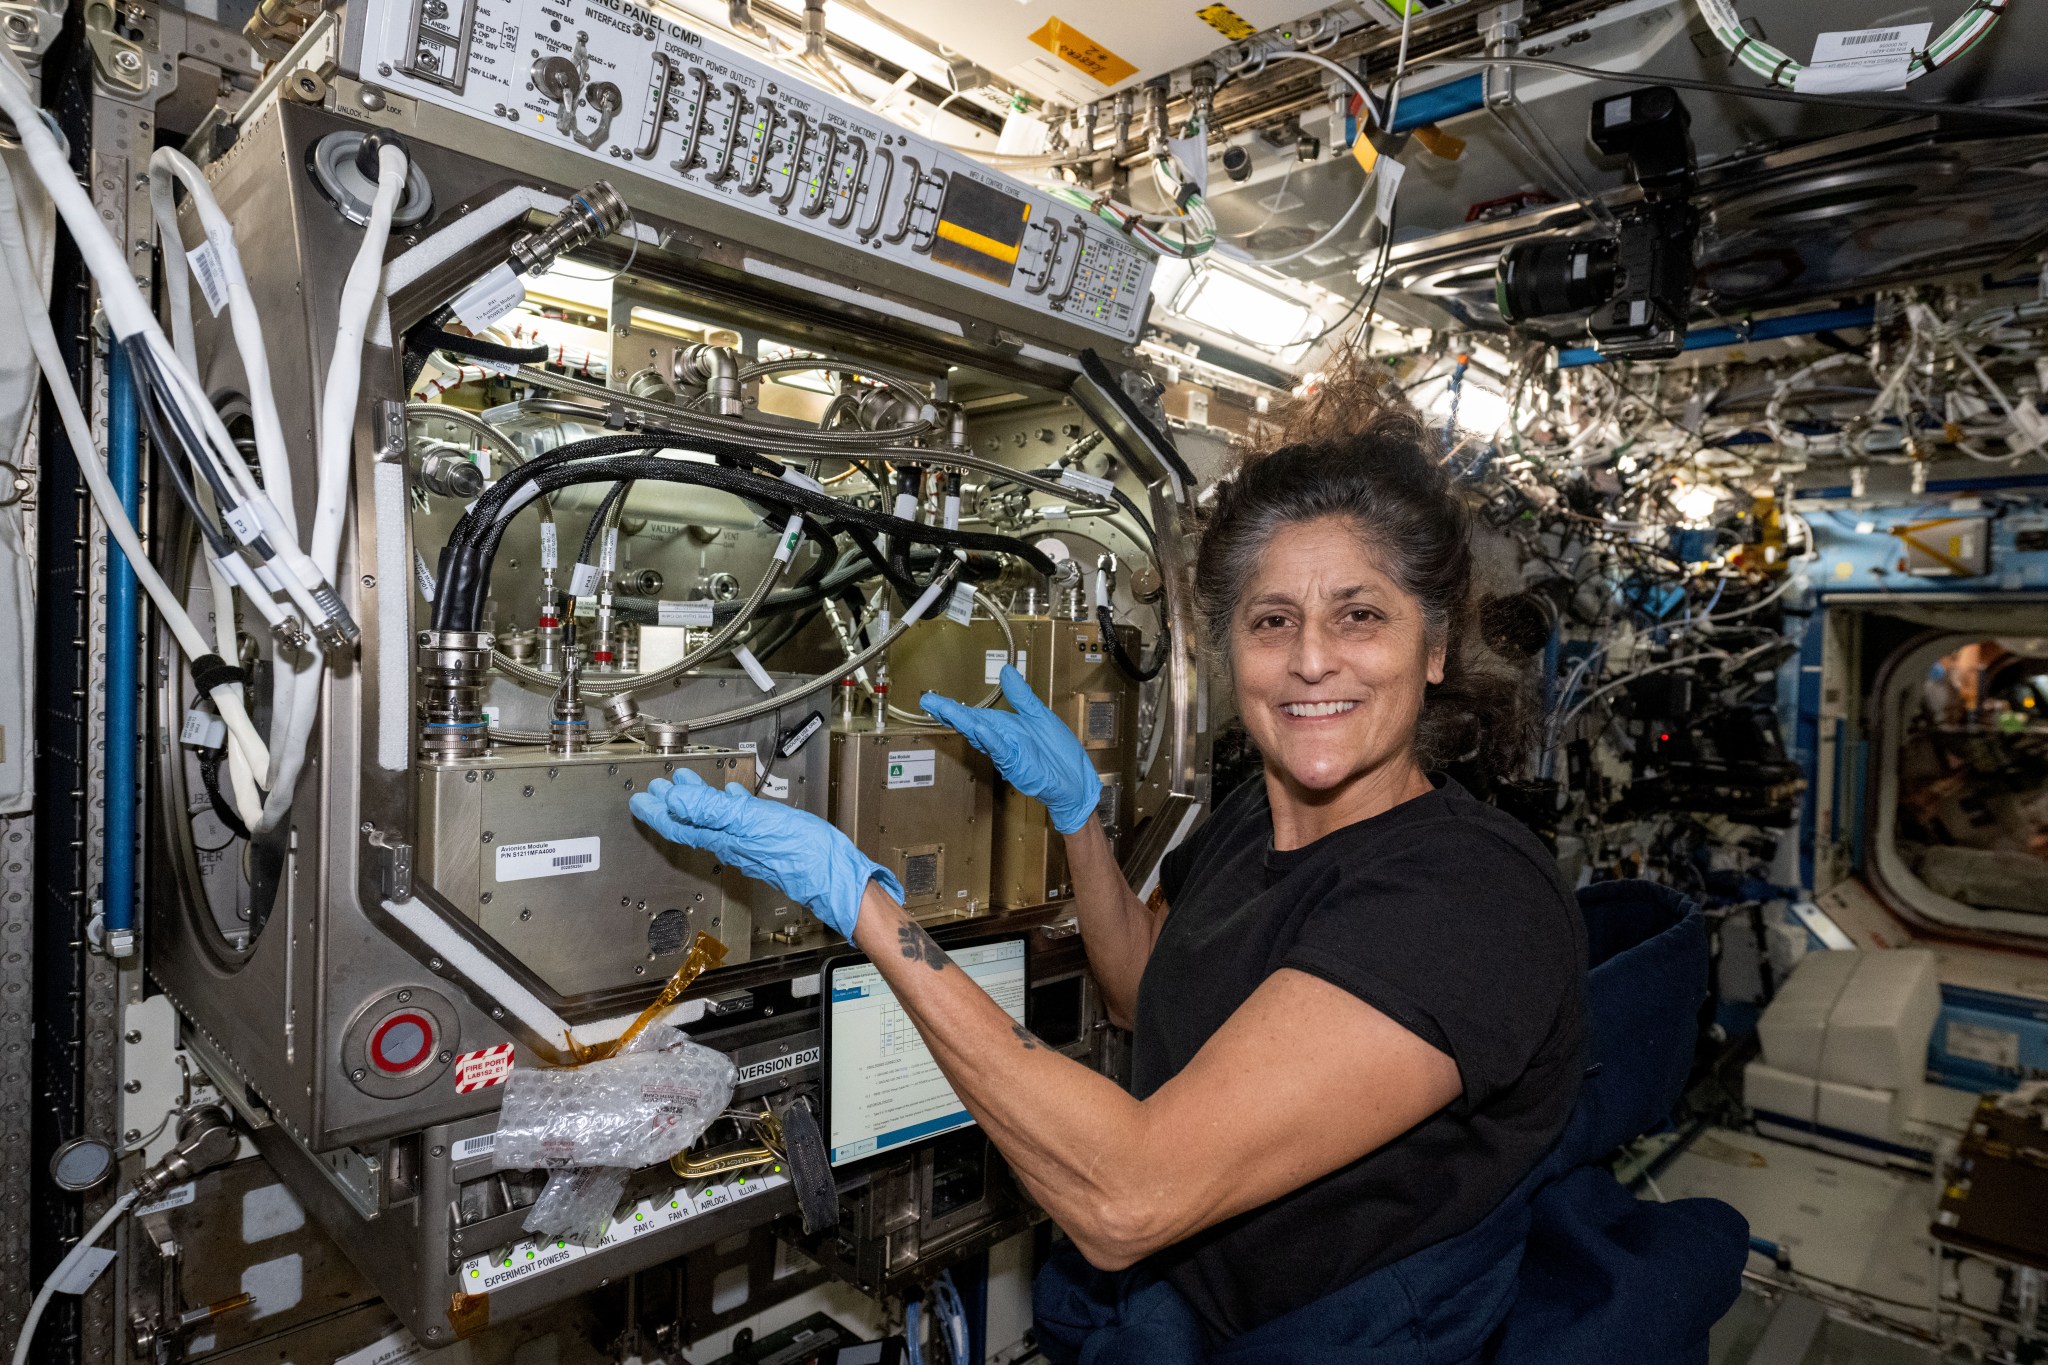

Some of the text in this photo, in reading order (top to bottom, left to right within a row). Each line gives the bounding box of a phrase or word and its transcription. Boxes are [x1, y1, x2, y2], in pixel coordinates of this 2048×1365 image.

[423, 17, 451, 32] STANDBY
[585, 6, 632, 34] INTERFACES
[622, 2, 665, 31] PANEL
[667, 22, 703, 48] (CMP)
[485, 25, 498, 35] EXP
[664, 41, 757, 89] EXPERIMENT POWER OUTLETS
[779, 92, 811, 111] FUNCTIONS
[337, 105, 362, 119] UNLOCK
[386, 105, 402, 116] LOCK
[827, 113, 848, 128] SPECIAL
[849, 122, 877, 141] FUNCTIONS
[680, 172, 695, 182] OUTLET
[985, 177, 1003, 191] CONTROL
[234, 519, 248, 534] P3
[651, 524, 679, 535] VACUUM
[723, 531, 740, 541] VENT
[783, 735, 801, 752] GROUND
[800, 727, 810, 737] USE
[808, 717, 820, 730] ONLY
[501, 845, 526, 853] Avionics
[795, 1048, 819, 1066] BOX
[465, 1057, 506, 1073] FIRE PORT
[700, 1194, 728, 1211] AIRLOCK
[668, 1208, 690, 1222] FAN R
[633, 1220, 656, 1235] FAN C
[612, 1233, 618, 1243] L
[465, 1260, 480, 1271] +5V
[484, 1251, 571, 1288] EXPERIMENT POWERS
